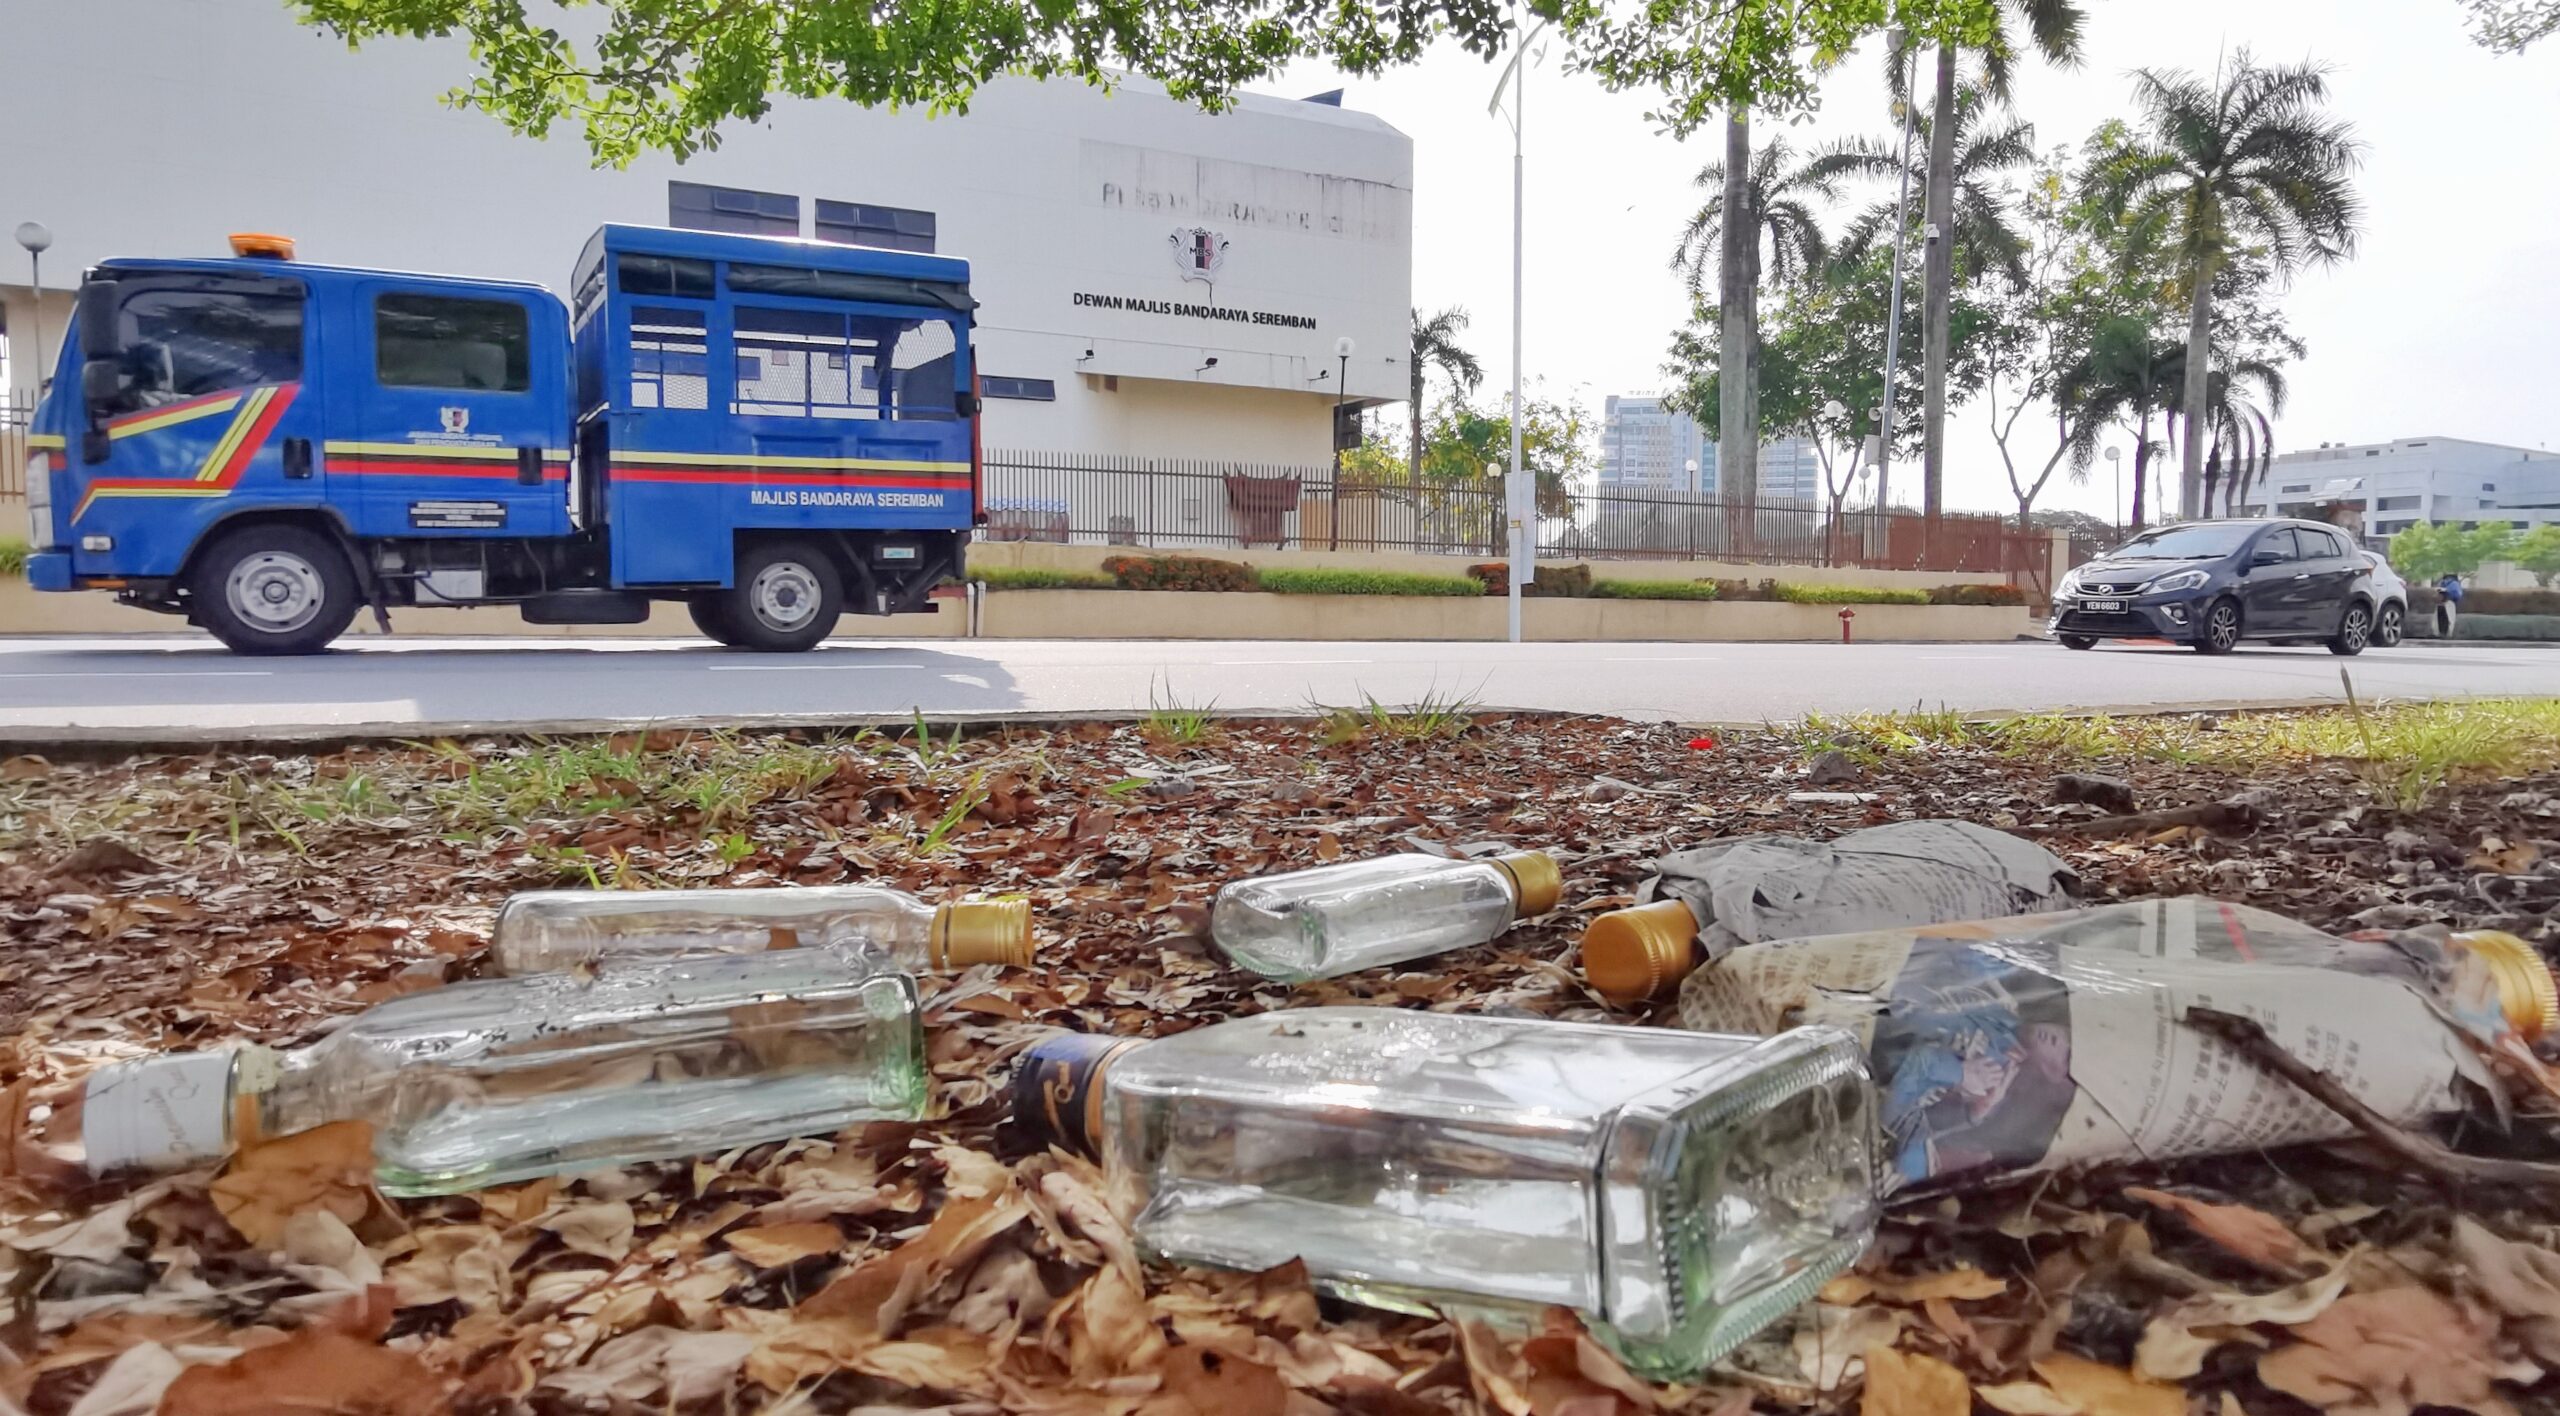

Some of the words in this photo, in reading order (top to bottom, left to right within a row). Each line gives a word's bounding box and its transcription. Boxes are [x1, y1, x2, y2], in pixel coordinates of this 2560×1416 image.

[1073, 292, 1123, 310] DEWAN
[1125, 297, 1171, 315] MAJLIS
[1173, 302, 1250, 323] BANDARAYA
[1252, 311, 1317, 330] SEREMBAN
[751, 490, 798, 506] MAJLIS
[800, 491, 875, 507] BANDARAYA
[877, 492, 944, 508] SEREMBAN
